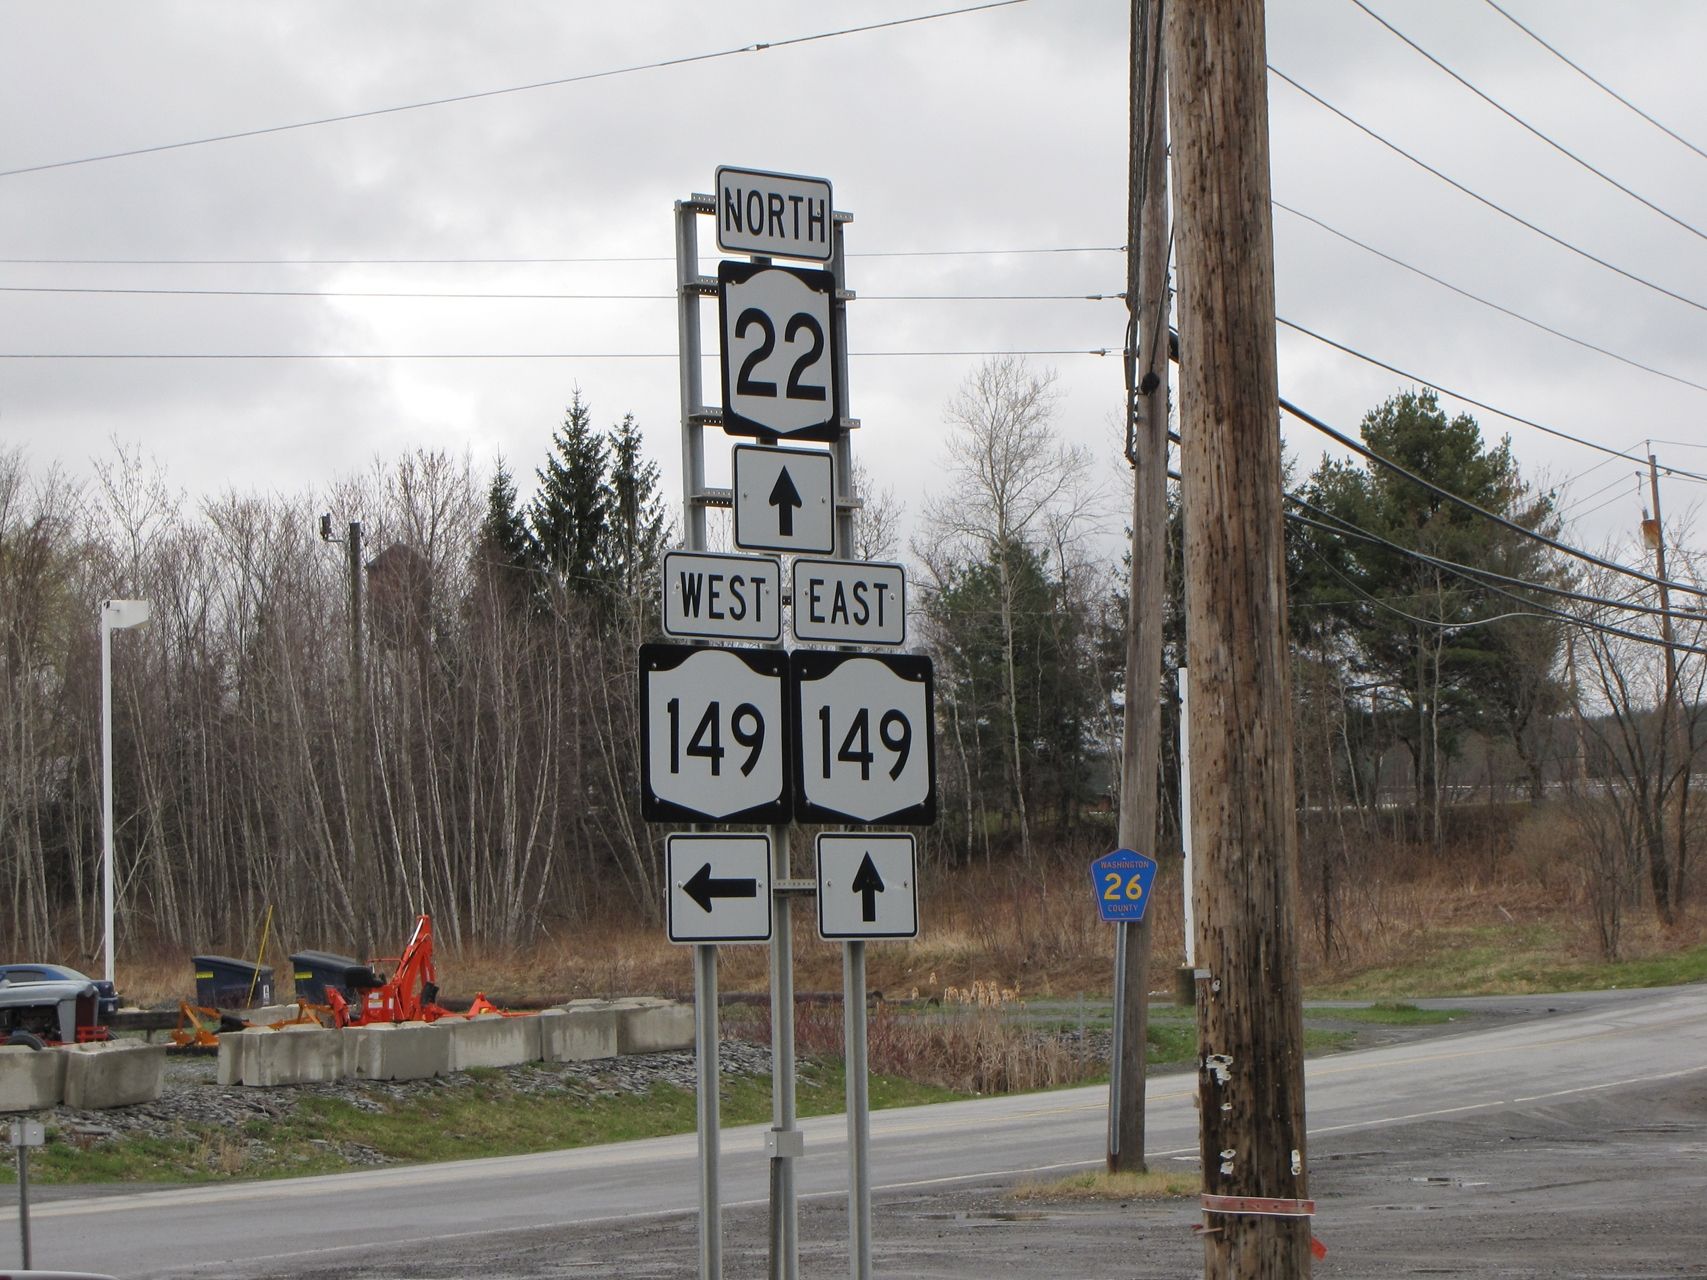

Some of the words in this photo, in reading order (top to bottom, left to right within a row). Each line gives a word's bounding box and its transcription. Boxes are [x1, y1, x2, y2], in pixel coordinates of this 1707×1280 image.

[724, 187, 826, 244] NORTH
[735, 307, 827, 402] 22
[680, 571, 766, 623] WEST
[809, 578, 889, 627] EAST
[667, 697, 766, 778] 149
[818, 705, 912, 782] 149
[1100, 861, 1149, 869] WASHINGTON
[1104, 872, 1143, 900] 26
[1107, 904, 1138, 912] COUNTY
